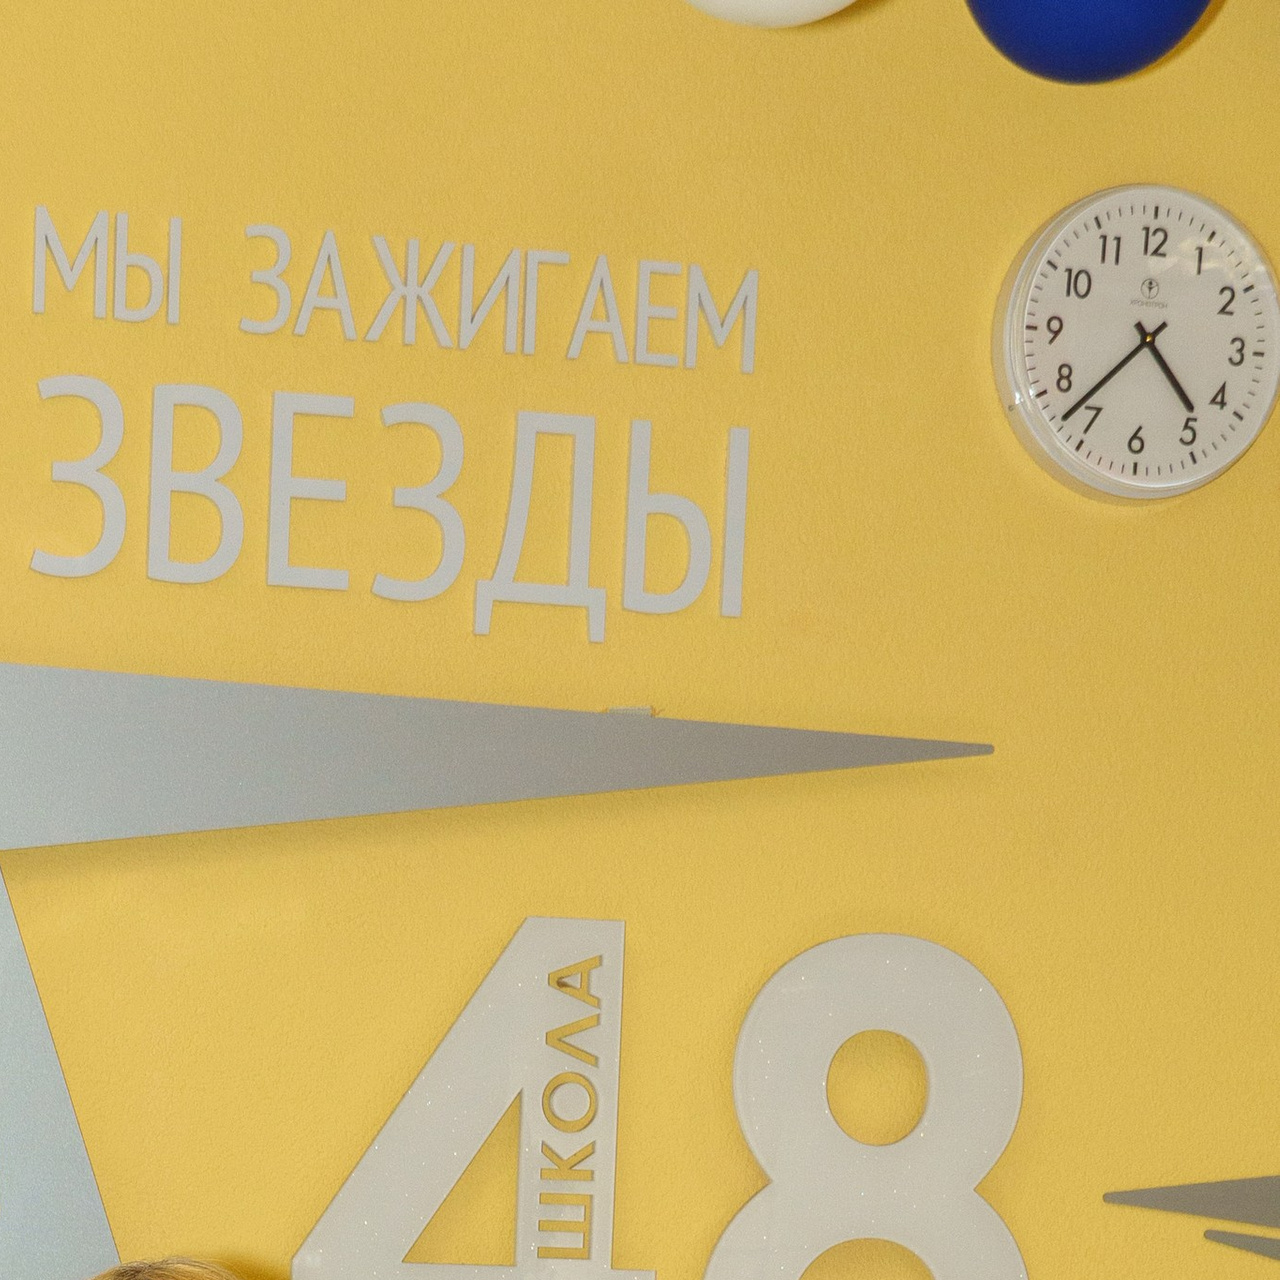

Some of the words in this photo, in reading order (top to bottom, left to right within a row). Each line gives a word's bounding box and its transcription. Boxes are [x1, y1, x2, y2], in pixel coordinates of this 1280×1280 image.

[1099, 235, 1122, 266] 11
[1141, 226, 1169, 258] 12
[1195, 247, 1204, 275] 1
[32, 205, 182, 325] МЫ
[240, 224, 759, 374] ЗАЖИГАЕМ
[1065, 268, 1092, 299] 10
[1217, 286, 1237, 316] 2
[1046, 316, 1064, 345] 9
[1228, 337, 1246, 366] 3
[1056, 363, 1073, 393] 8
[1208, 381, 1228, 410] 4
[1084, 405, 1104, 434] 7
[1179, 417, 1198, 446] 5
[1127, 426, 1146, 454] 6
[30, 374, 750, 642] ЗВЕЗДЫ
[536, 955, 603, 1260] ШКОЛА
